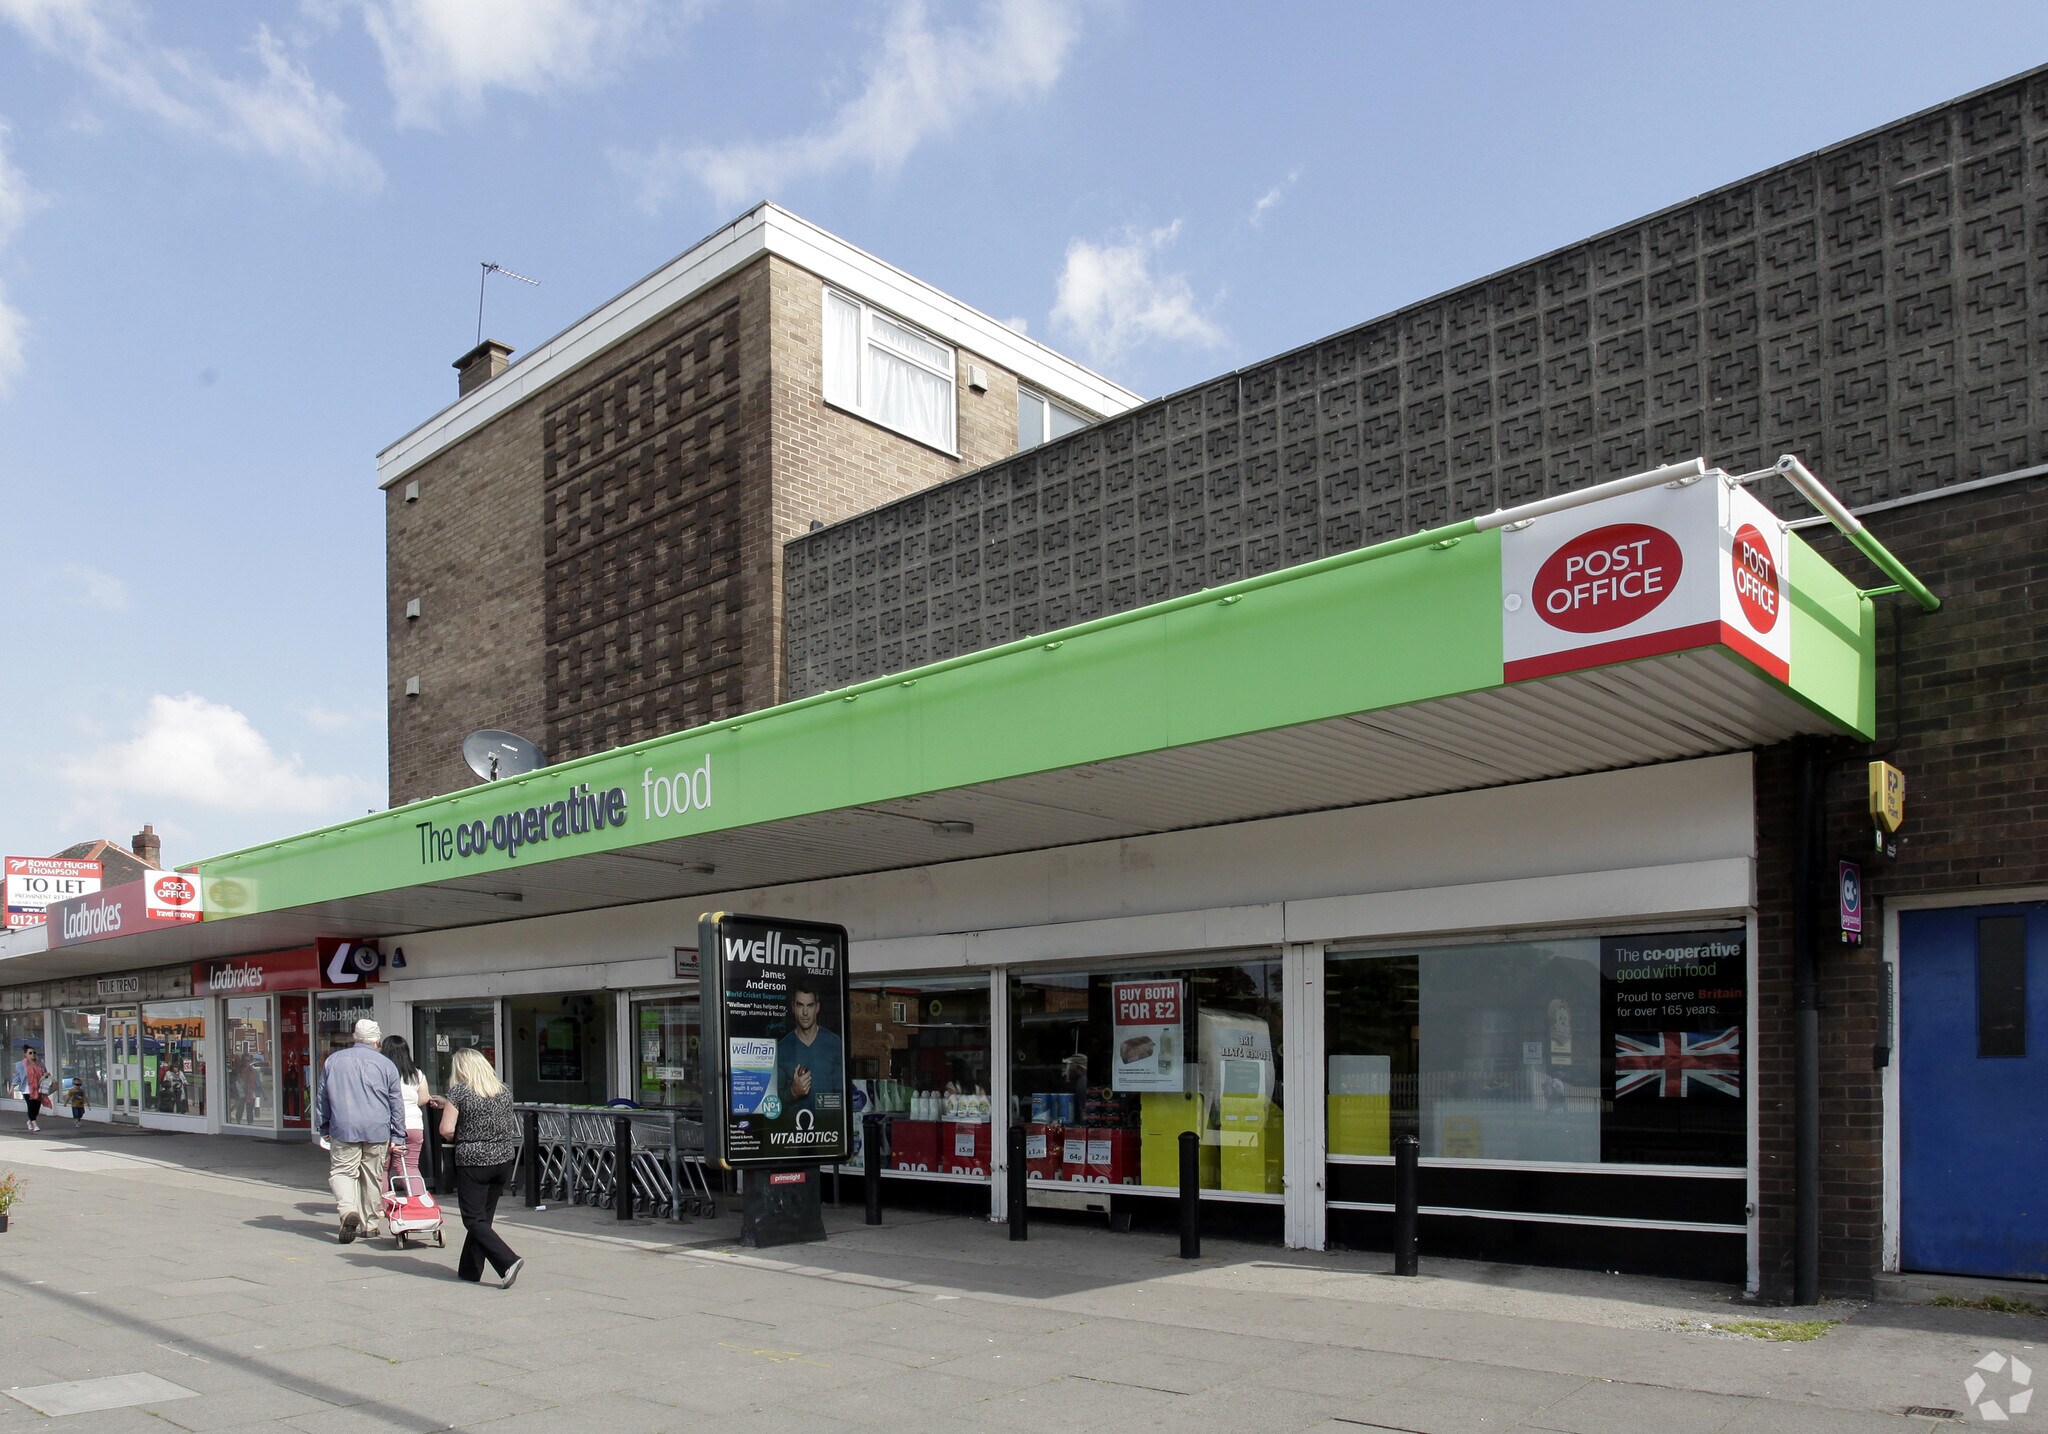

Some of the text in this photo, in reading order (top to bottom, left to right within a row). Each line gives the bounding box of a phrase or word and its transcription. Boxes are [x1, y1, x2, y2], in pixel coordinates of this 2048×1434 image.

[1566, 539, 1651, 582] POST
[1742, 541, 1770, 582] POST
[1546, 566, 1663, 614] OFFICE
[1736, 567, 1775, 616] OFFICE
[416, 753, 712, 865] The co-operative food
[28, 859, 99, 870] ROWLEY HUGHES
[28, 867, 79, 876] THOMPSON
[22, 877, 86, 894] TO LET
[162, 881, 188, 891] POST
[157, 889, 191, 900] OFFICE
[10, 914, 39, 925] 0121
[63, 897, 122, 940] Ladbrokes
[174, 912, 196, 920] money
[725, 930, 836, 969] wellman
[1615, 942, 1741, 962] The co-operative
[209, 961, 263, 990] Ladbrokes
[760, 969, 786, 980] James
[807, 967, 834, 977] TABLETS
[1616, 961, 1717, 983] good with food
[99, 978, 138, 994] TRUE TREND
[745, 979, 787, 991] Anderson
[1119, 985, 1175, 1001] BUY BOTH
[1617, 989, 1743, 1003] Proud to serve Britain
[1119, 1001, 1176, 1020] FOR £2
[1617, 1005, 1720, 1018] for over 165 years.
[732, 1042, 775, 1055] wellman
[770, 1130, 839, 1145] VITABIOTICS
[1069, 1153, 1083, 1162] 64p
[774, 1173, 801, 1183] primesight
